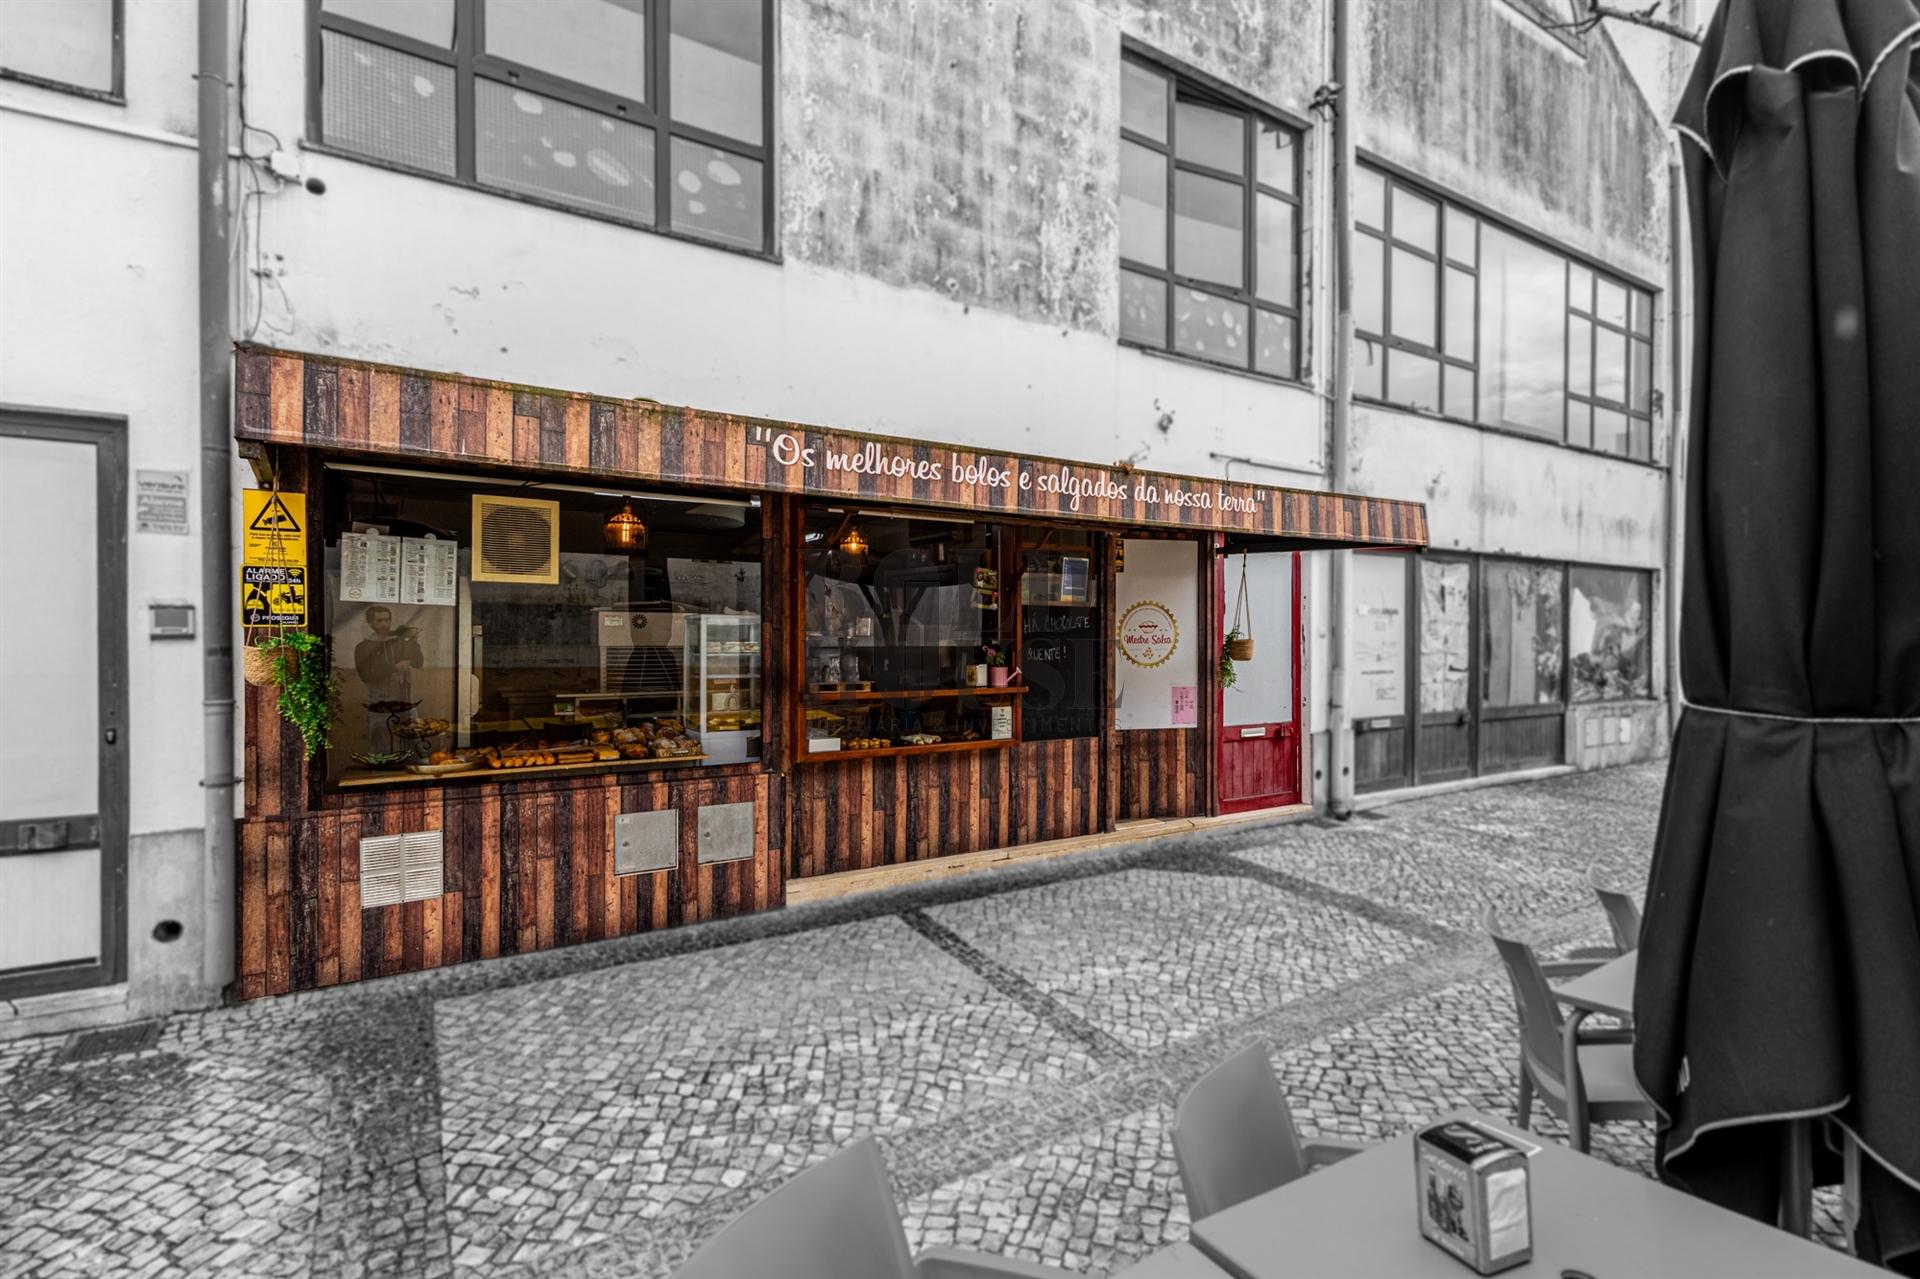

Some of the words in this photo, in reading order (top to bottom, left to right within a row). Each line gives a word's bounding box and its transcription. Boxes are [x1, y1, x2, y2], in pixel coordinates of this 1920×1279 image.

[826, 442, 942, 482] melhores
[951, 452, 1012, 488] bolos
[1019, 471, 1033, 491] e
[1037, 466, 1129, 515] salgados
[1133, 475, 1161, 505] da
[1164, 489, 1215, 510] nossa
[246, 567, 285, 575] ALARME
[246, 573, 286, 581] LIGADO
